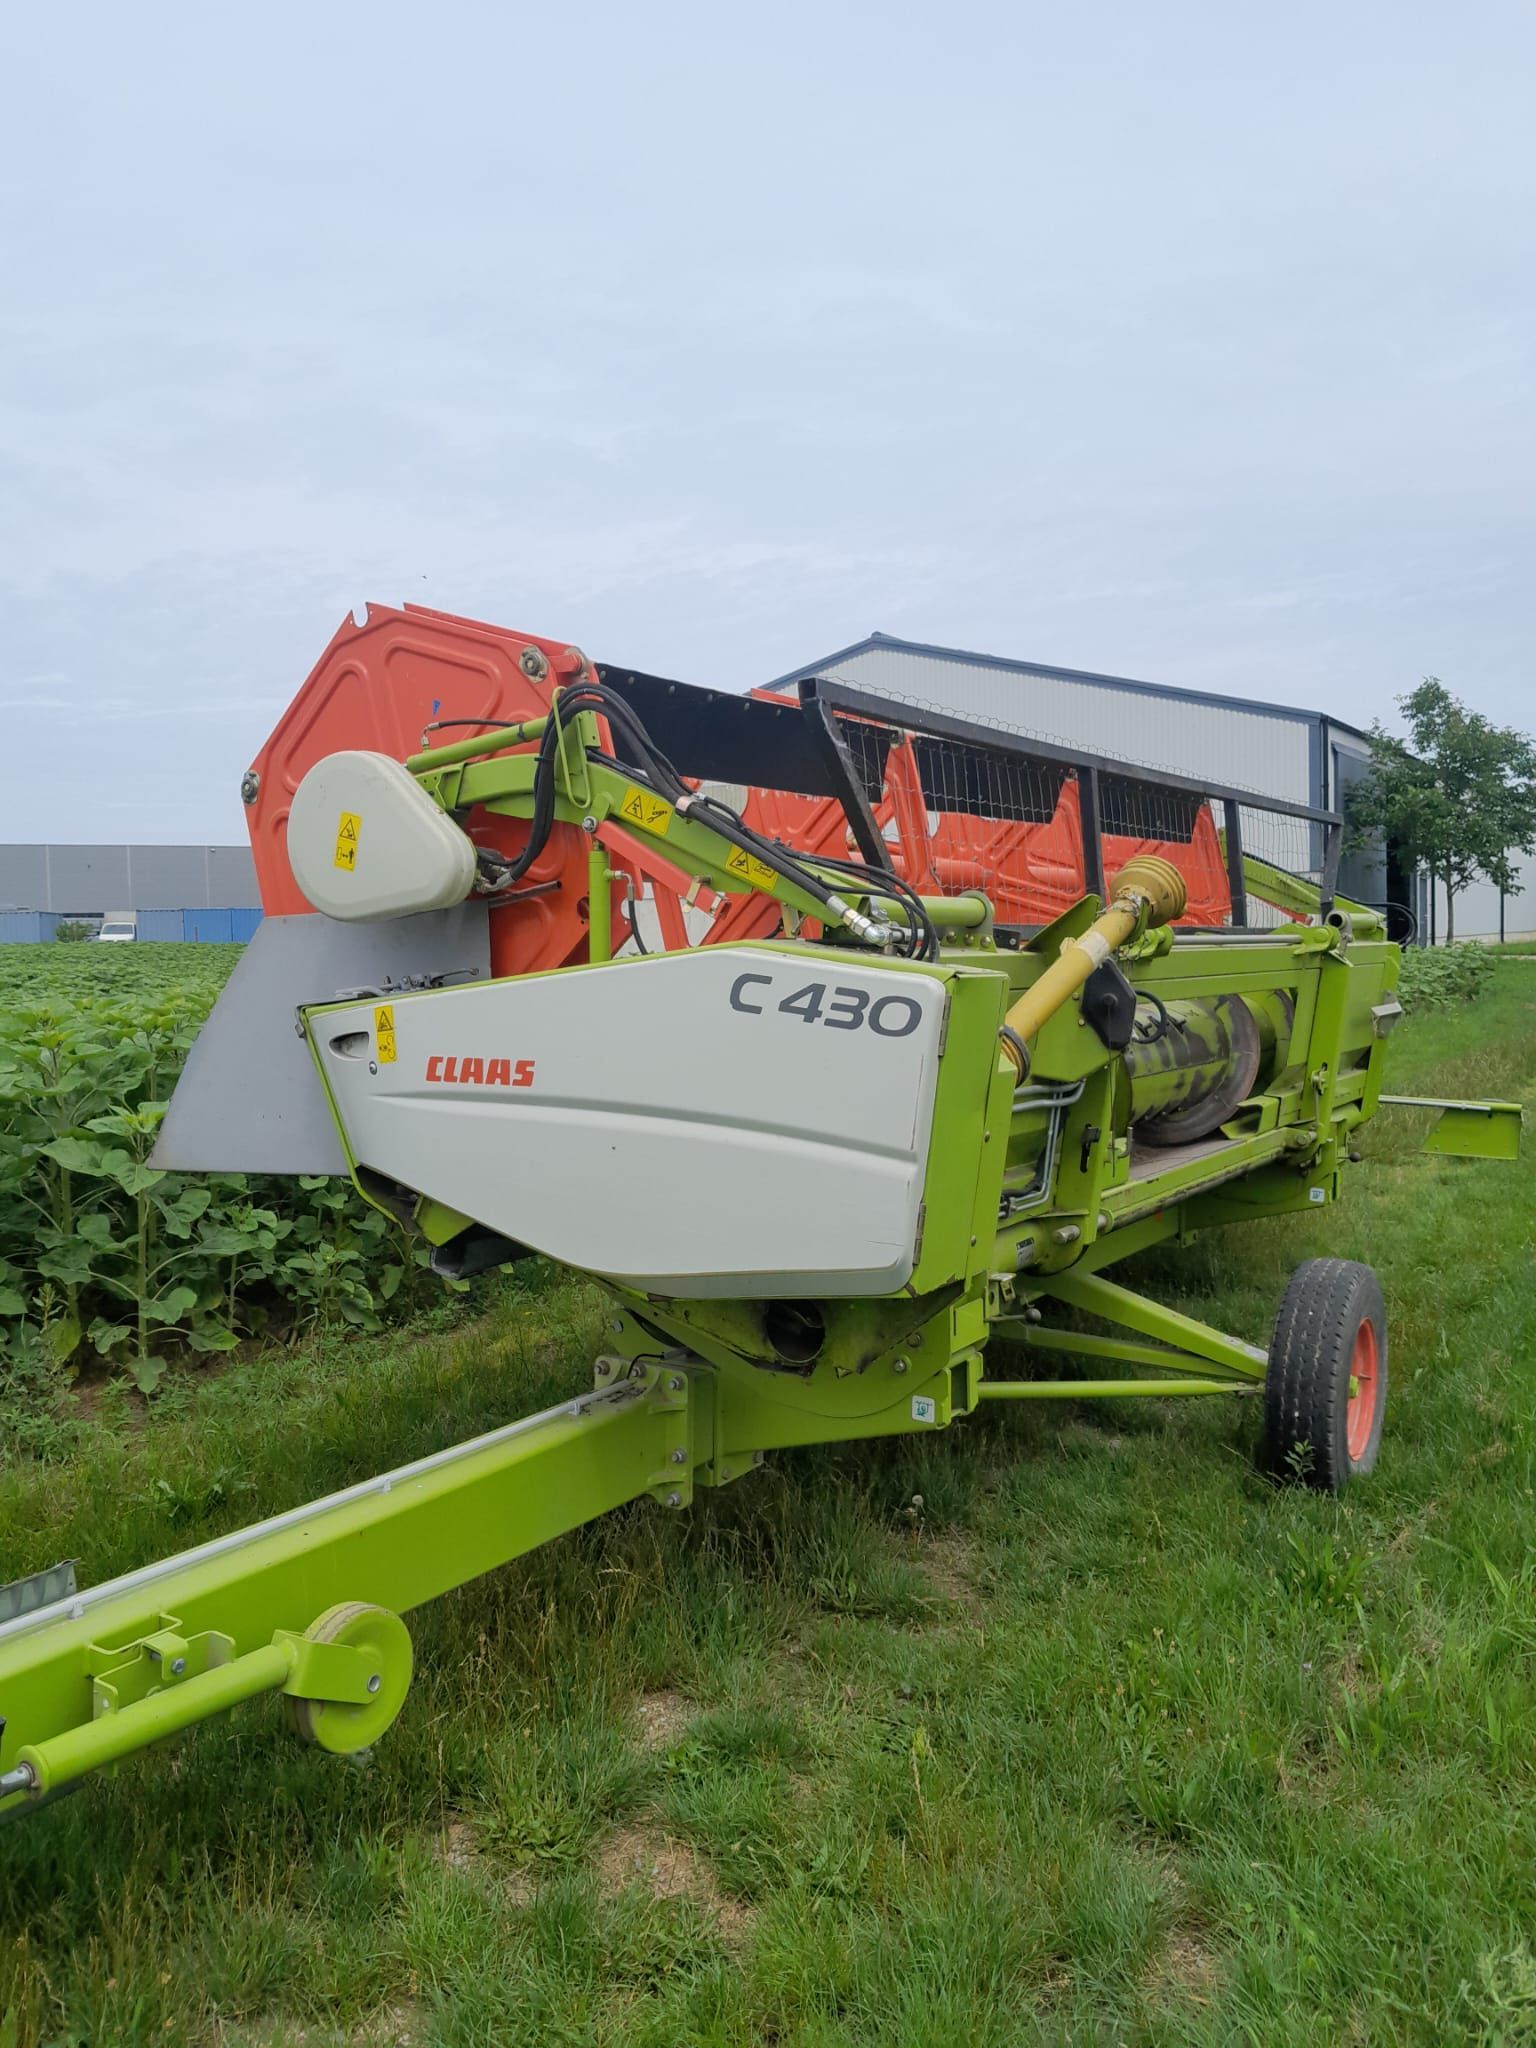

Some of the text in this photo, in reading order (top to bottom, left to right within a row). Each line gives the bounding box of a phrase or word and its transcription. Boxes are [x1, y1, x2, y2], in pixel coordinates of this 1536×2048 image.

[729, 972, 923, 1038] C 430
[425, 1056, 535, 1087] CLAAS
